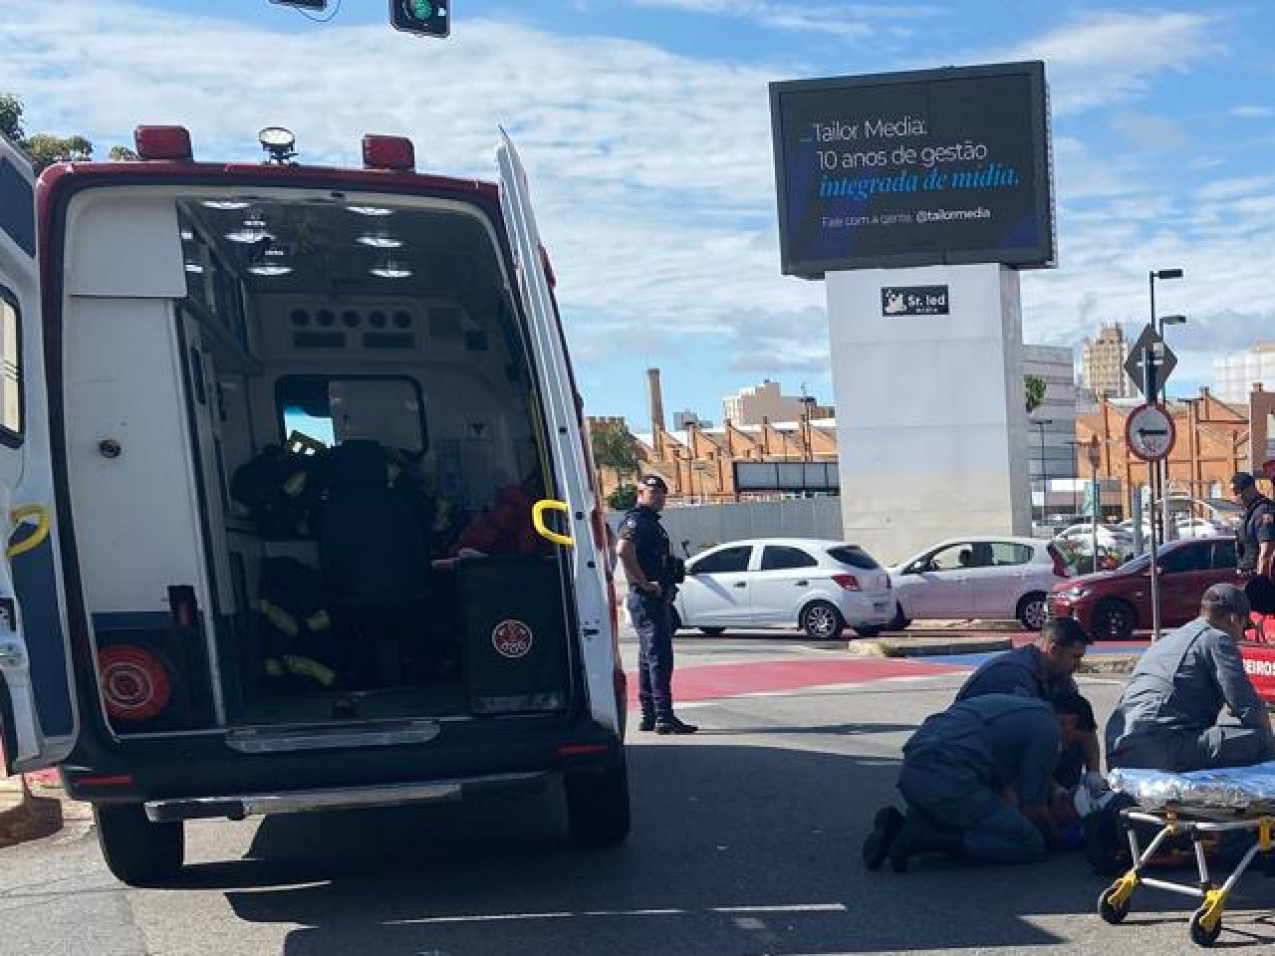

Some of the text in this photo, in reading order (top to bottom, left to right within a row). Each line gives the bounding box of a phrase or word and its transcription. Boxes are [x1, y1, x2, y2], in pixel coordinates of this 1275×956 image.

[813, 120, 859, 142] Tailor
[816, 140, 988, 170] 10 anos de gestão
[819, 170, 918, 199] integrada
[923, 168, 948, 191] de
[915, 205, 991, 224] @tailormedia
